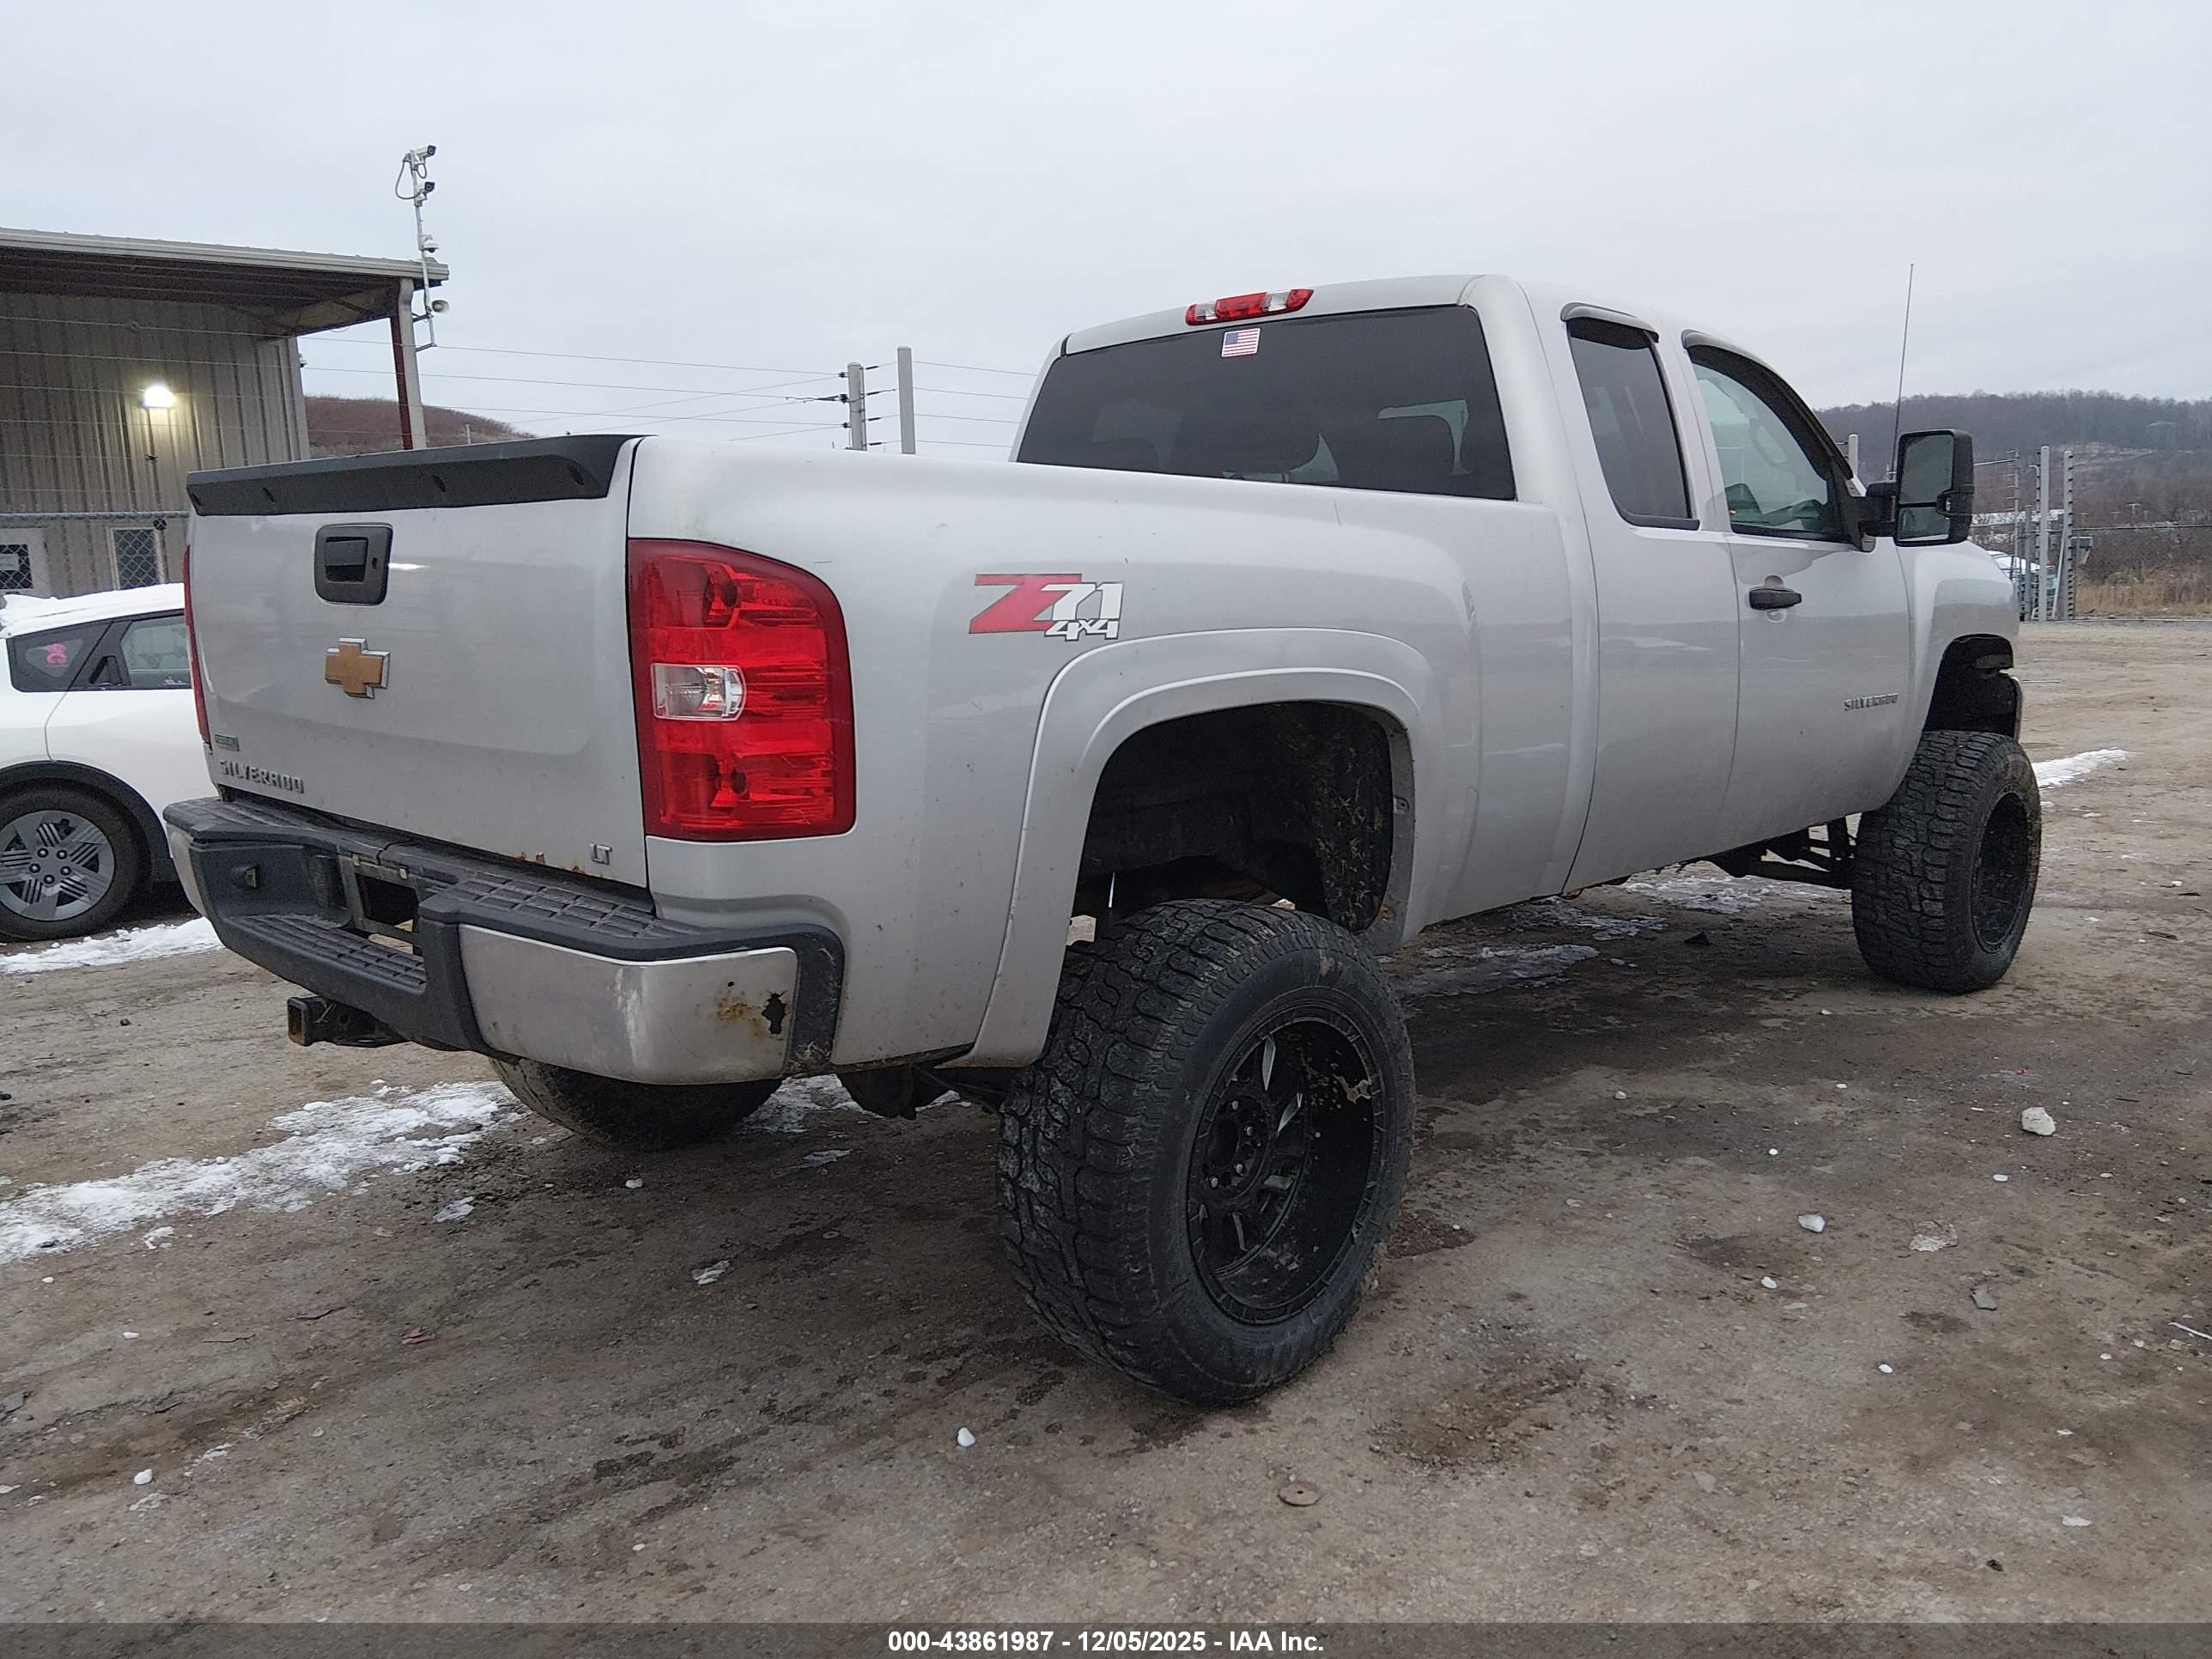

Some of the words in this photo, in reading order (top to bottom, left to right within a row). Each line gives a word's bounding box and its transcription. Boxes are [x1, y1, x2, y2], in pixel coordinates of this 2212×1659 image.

[969, 573, 1124, 634] Z71
[219, 759, 305, 793] SILVERADO
[590, 841, 613, 866] LT
